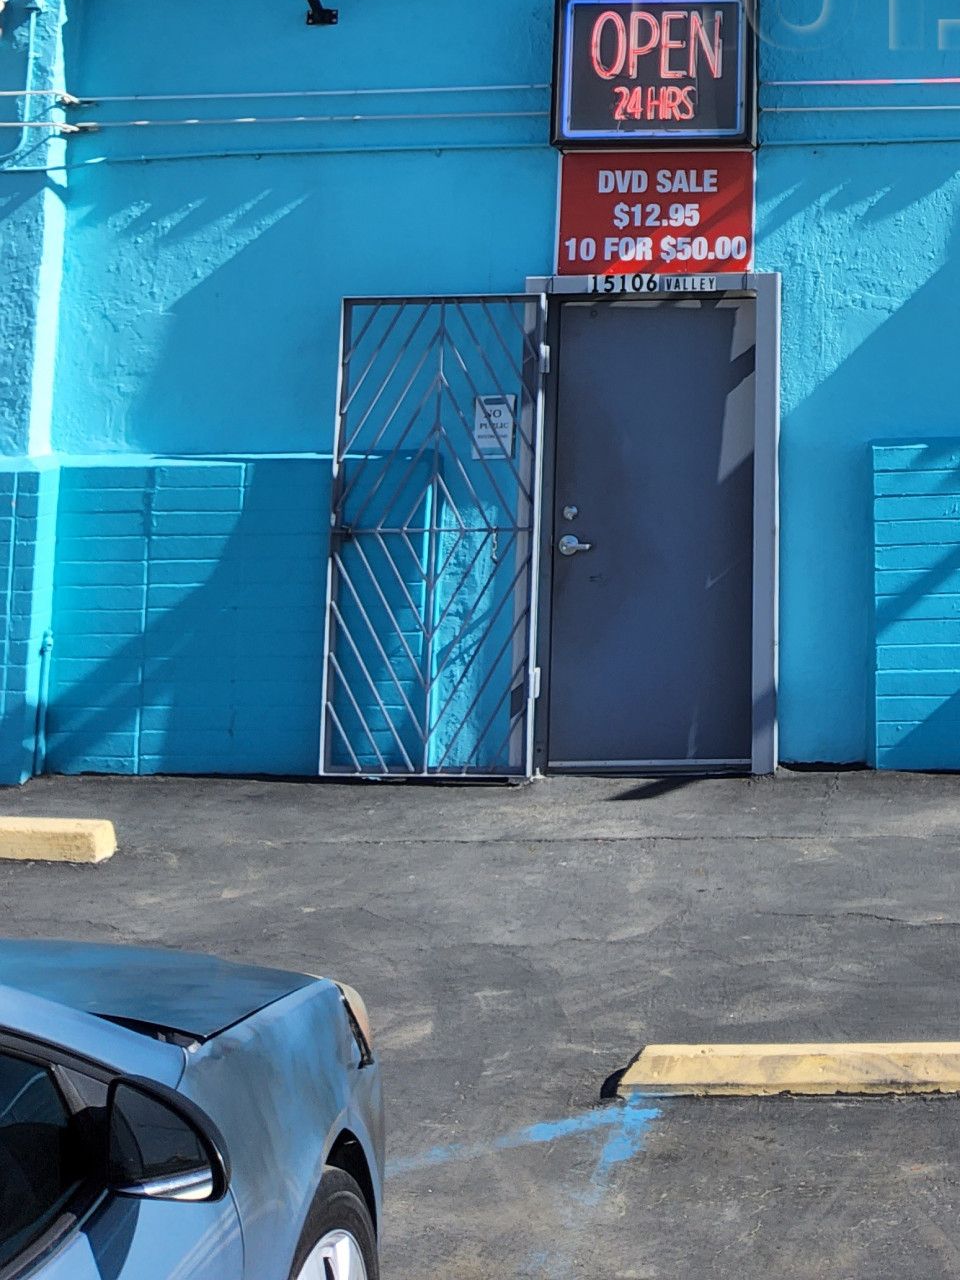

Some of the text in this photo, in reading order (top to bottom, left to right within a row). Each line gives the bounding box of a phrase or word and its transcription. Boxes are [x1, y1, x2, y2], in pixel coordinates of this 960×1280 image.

[591, 10, 723, 80] OPEN
[613, 86, 697, 120] 24 HRS
[598, 169, 718, 193] DVD SALE
[613, 202, 700, 229] $12.95
[565, 235, 747, 263] 10 FOR $50.00
[592, 274, 717, 292] 15106 VALLEY
